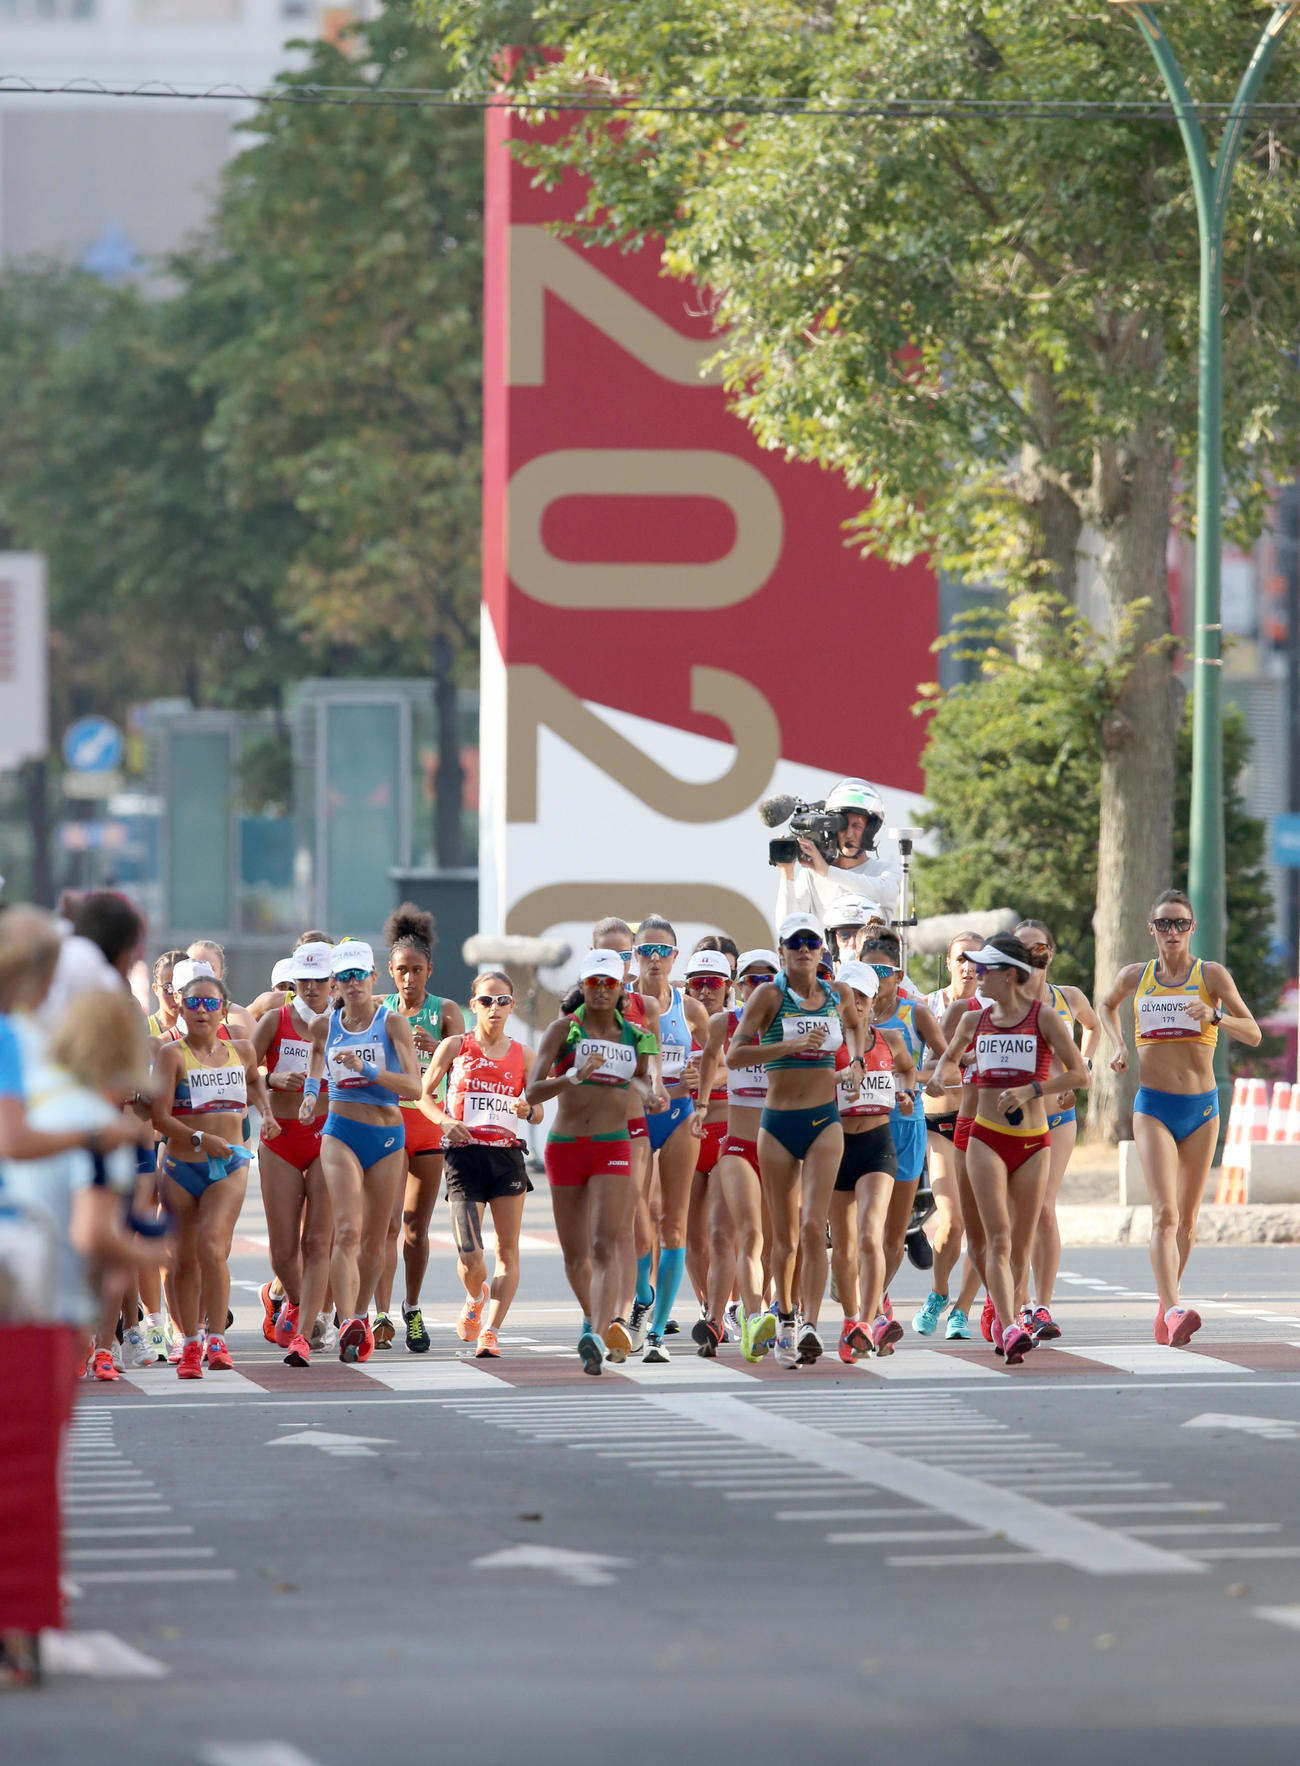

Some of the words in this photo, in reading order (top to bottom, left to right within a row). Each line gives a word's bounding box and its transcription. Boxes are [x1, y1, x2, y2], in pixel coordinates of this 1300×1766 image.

[1141, 1002, 1186, 1013] OLYANOVS
[283, 1046, 309, 1058] GARCI
[1000, 1055, 1009, 1063] 22
[191, 1071, 244, 1088] MOREJON
